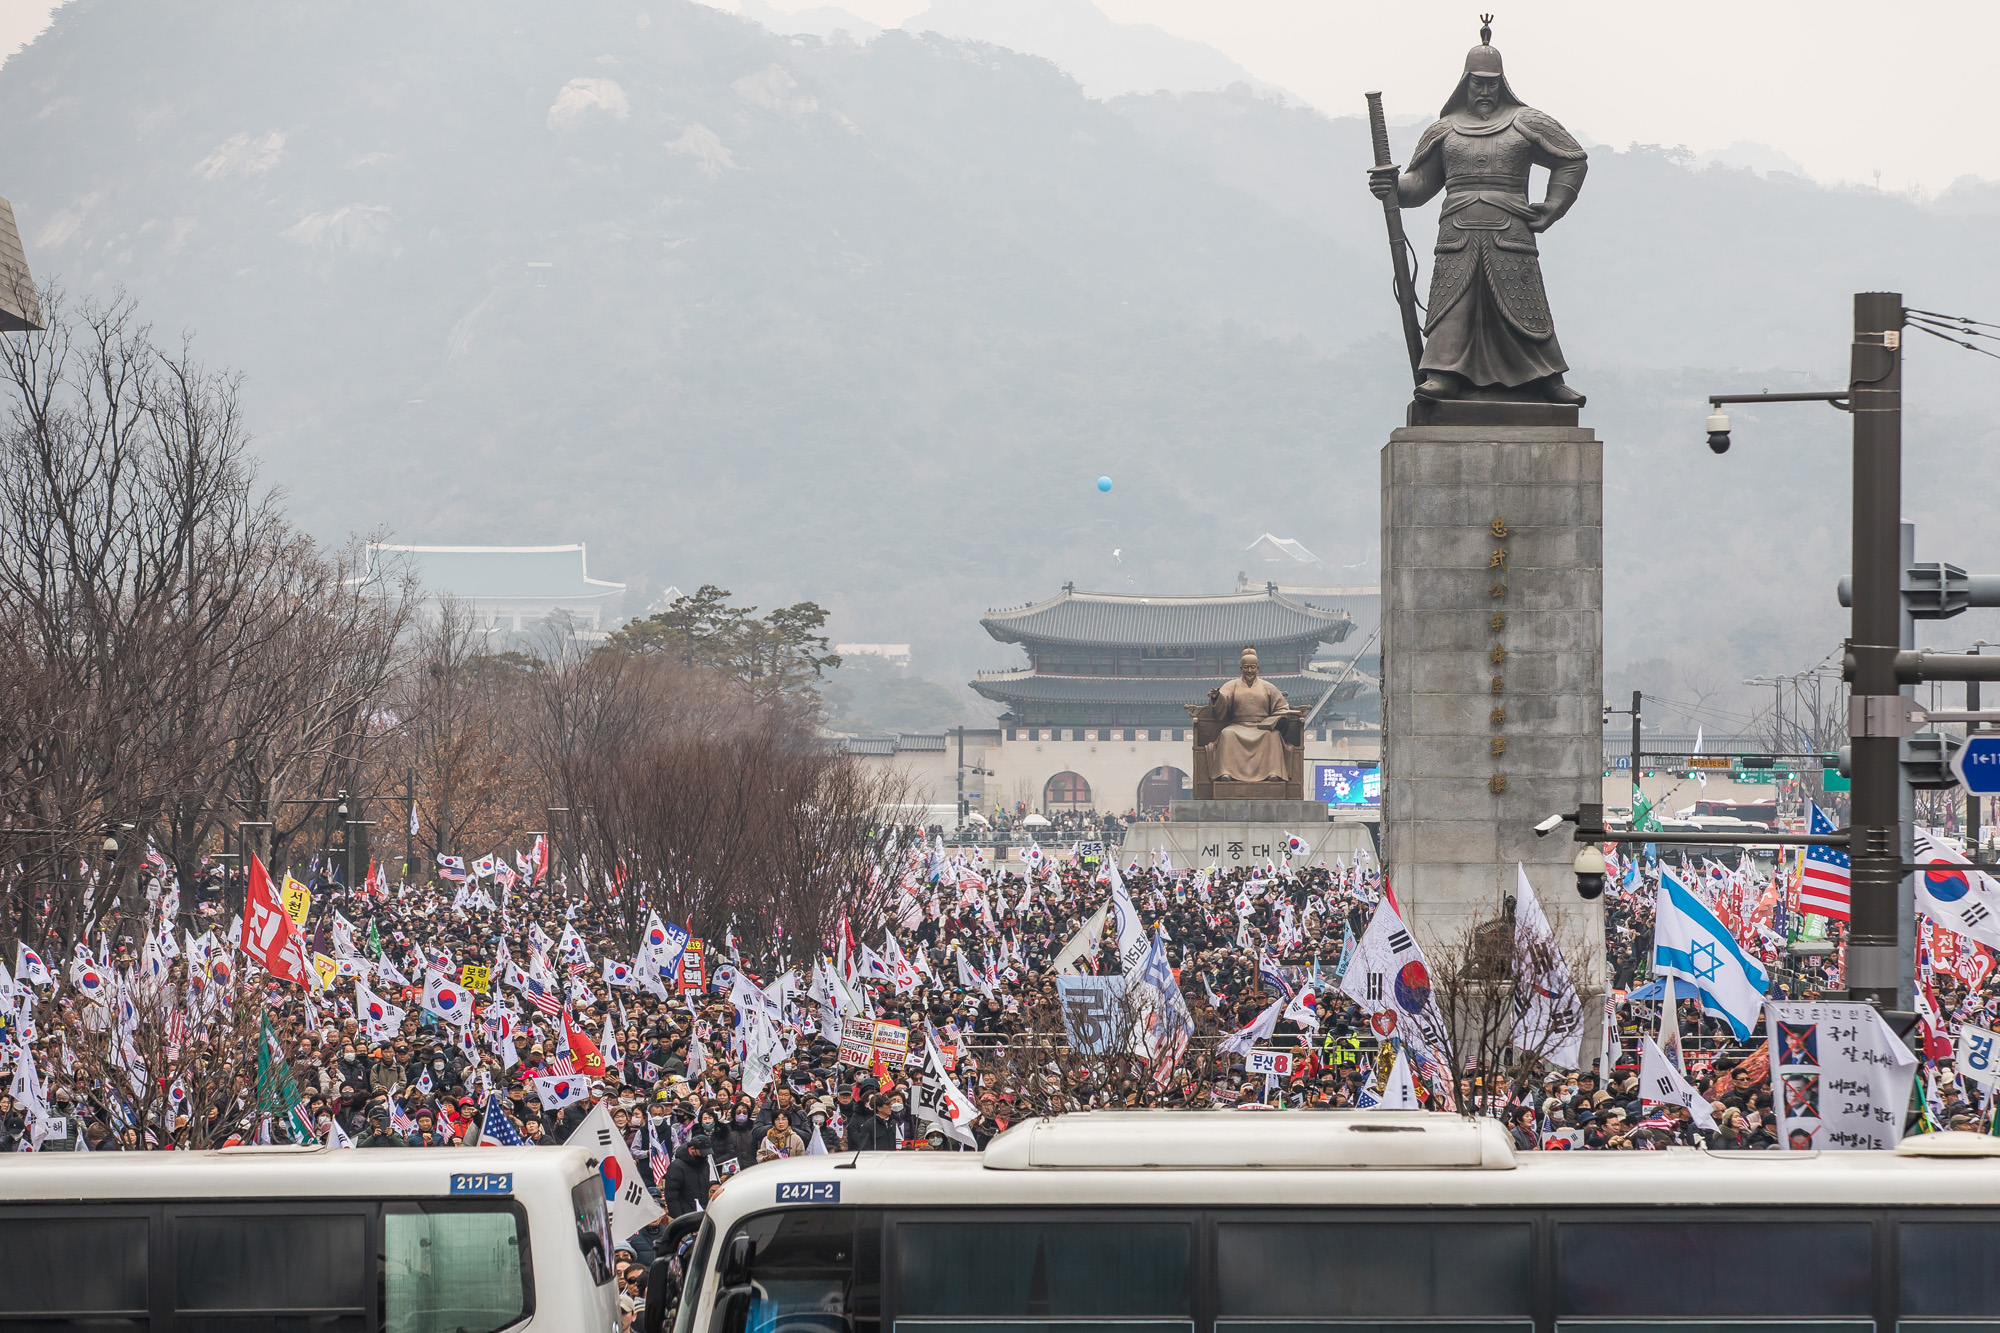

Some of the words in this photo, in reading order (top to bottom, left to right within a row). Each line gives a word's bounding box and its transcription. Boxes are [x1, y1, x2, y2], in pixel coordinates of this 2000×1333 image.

[1081, 842, 1102, 856] 경주
[1201, 841, 1292, 860] 세종대왕
[466, 966, 487, 978] 보령
[463, 975, 487, 990] 2호차
[840, 1049, 868, 1066] 열어!
[877, 1051, 904, 1062] 핵무효
[1842, 1045, 1859, 1062] 잘
[457, 1175, 507, 1191] 21기-2
[782, 1183, 833, 1200] 24기-2
